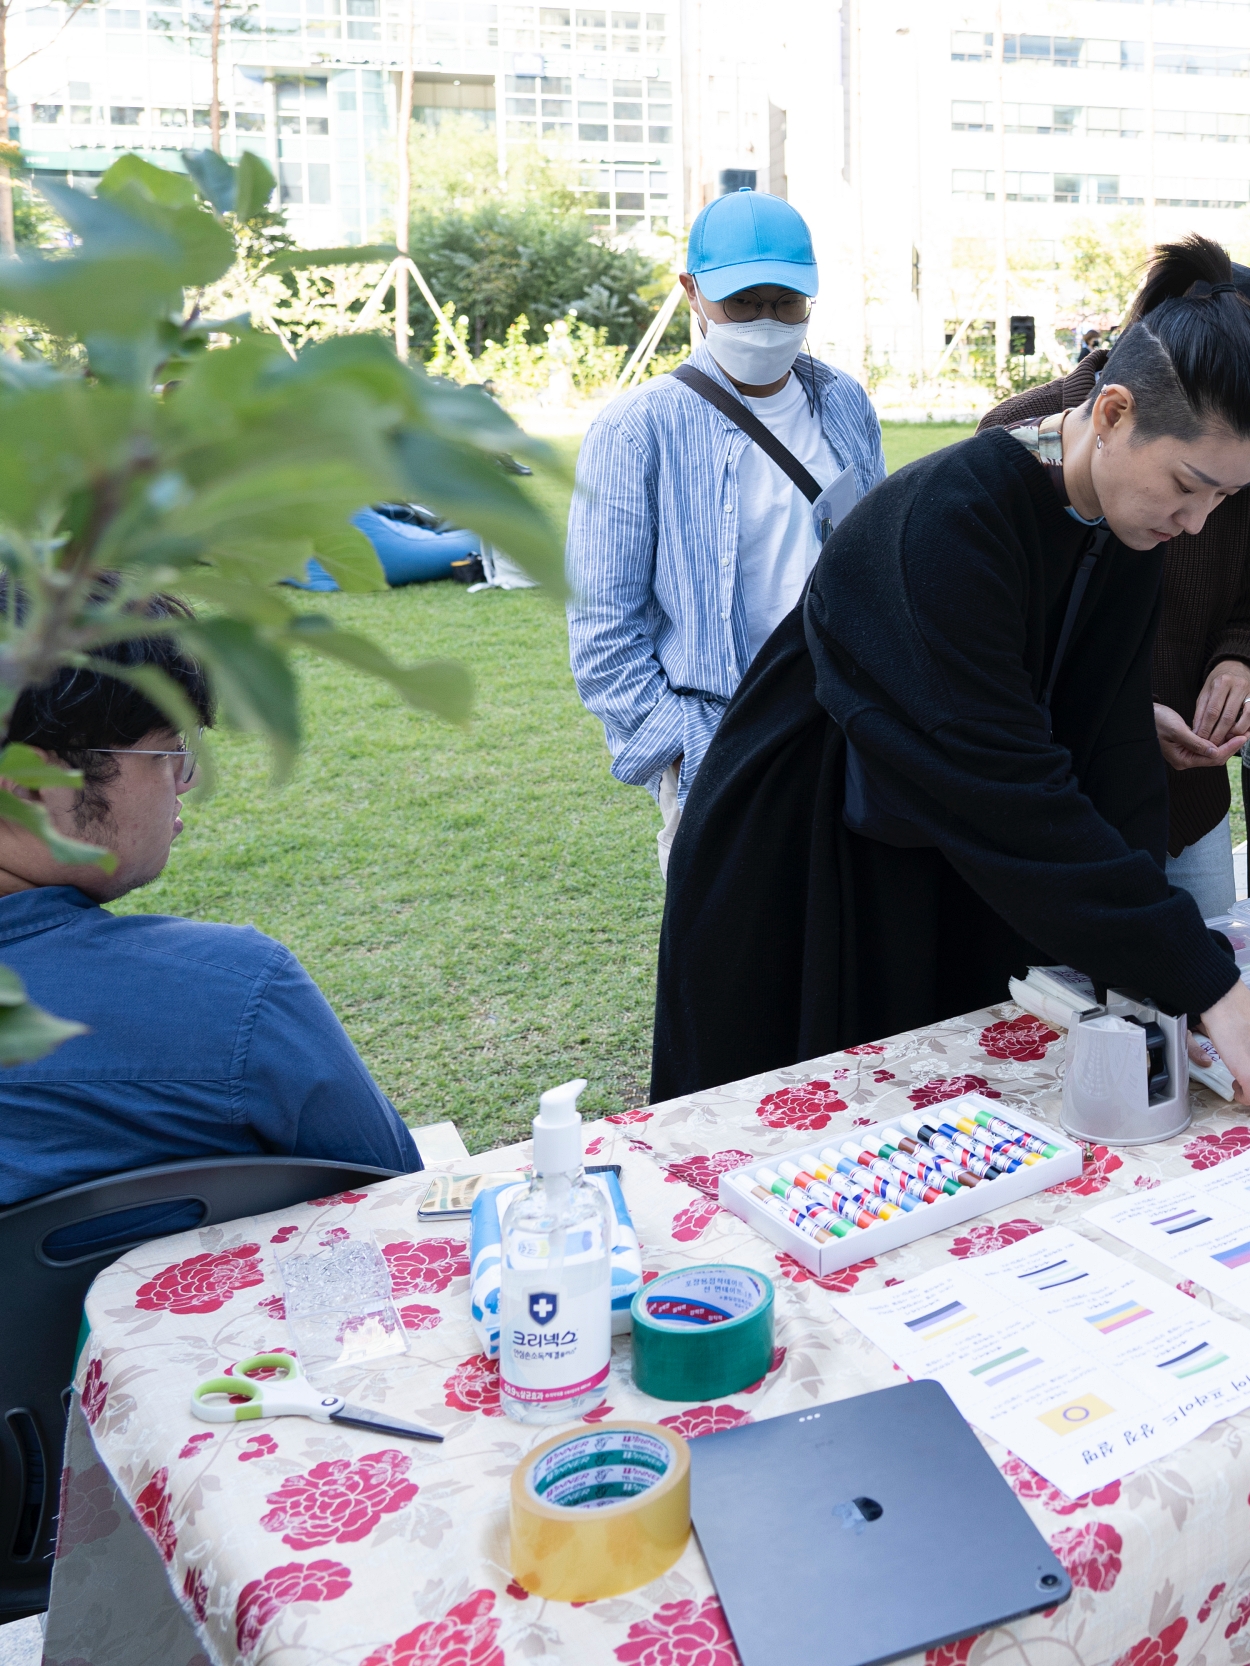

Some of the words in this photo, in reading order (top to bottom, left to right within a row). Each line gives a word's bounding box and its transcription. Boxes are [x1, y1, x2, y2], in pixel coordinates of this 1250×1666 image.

[512, 1330, 578, 1348] 크리넥스
[1162, 1387, 1223, 1427] 프라이드
[1123, 1423, 1155, 1446] 상징
[1081, 1441, 1114, 1465] 설명
